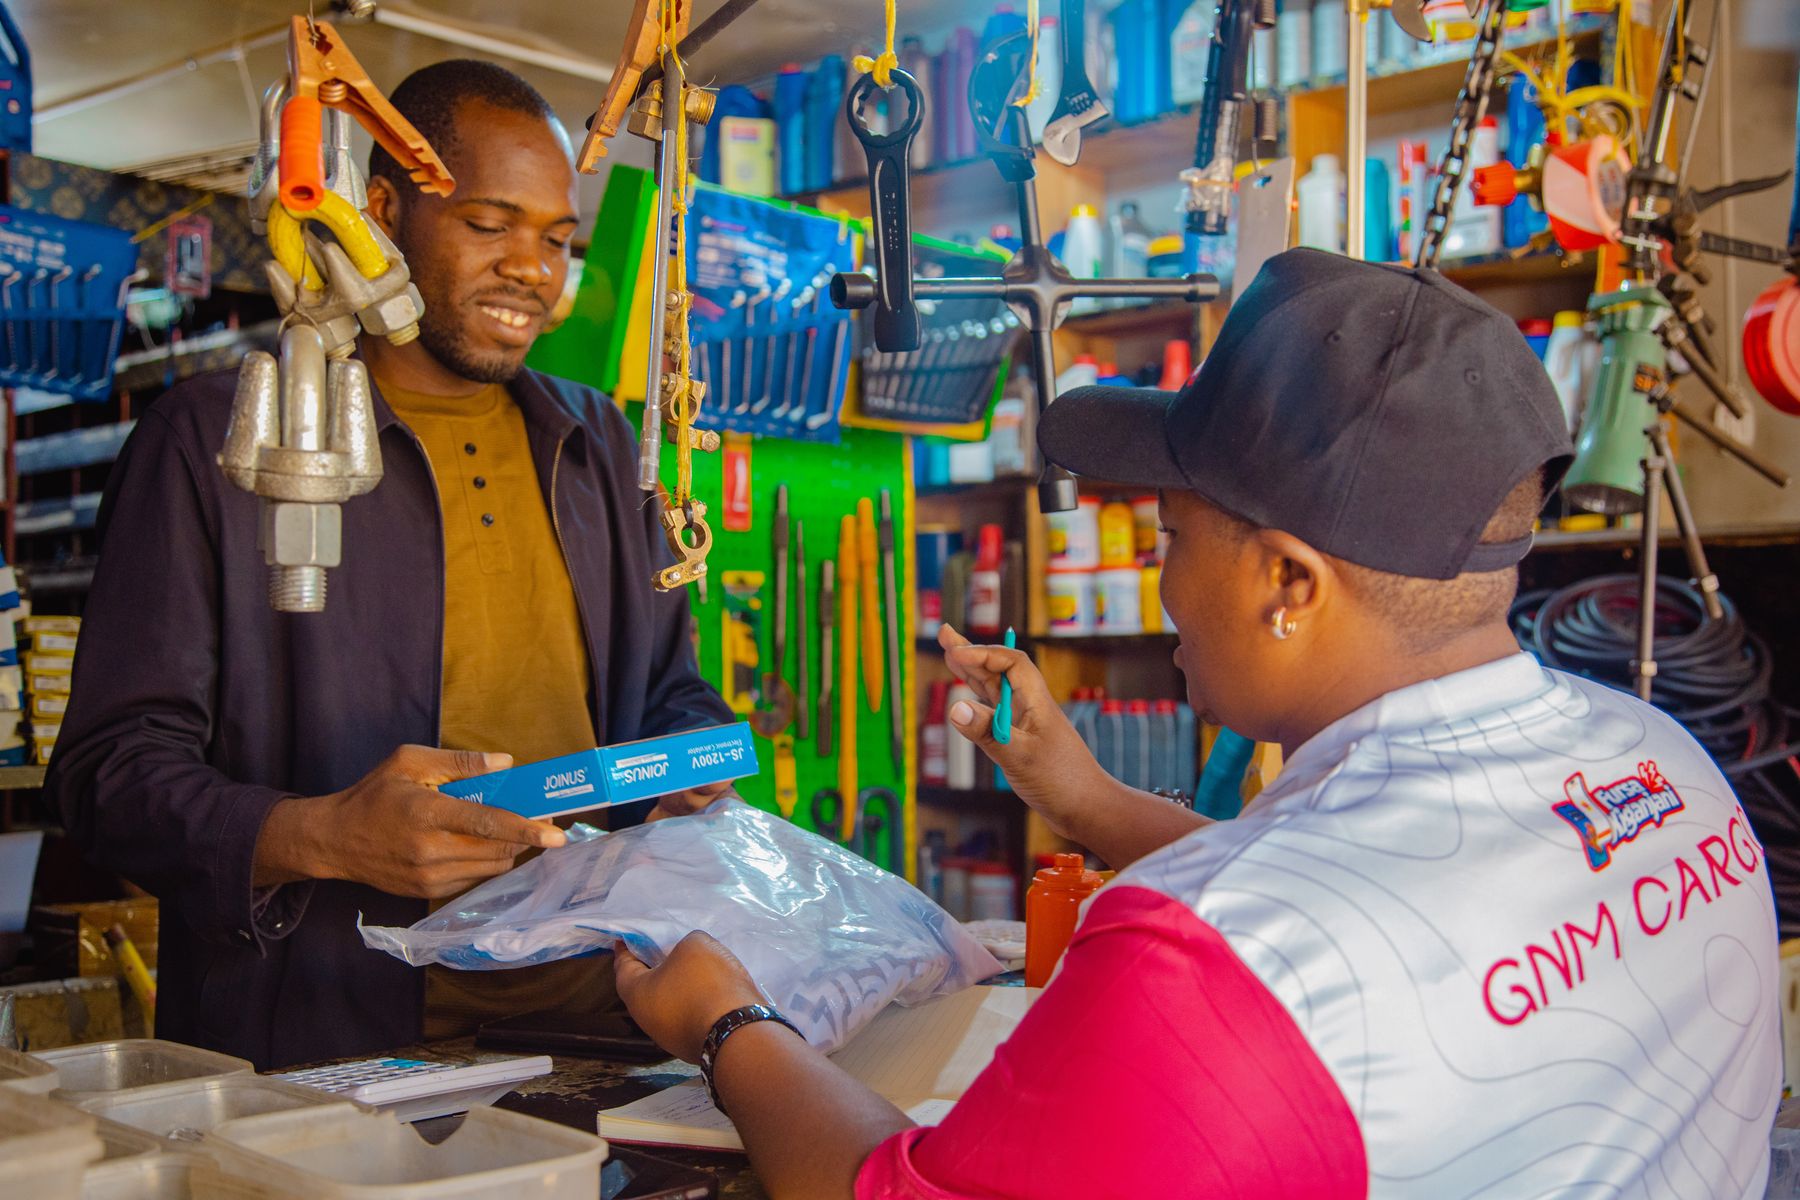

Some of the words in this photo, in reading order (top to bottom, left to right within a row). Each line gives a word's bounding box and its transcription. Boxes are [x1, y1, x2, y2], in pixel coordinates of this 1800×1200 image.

[716, 738, 743, 750] Electronic
[692, 748, 745, 769] JS-1200V
[543, 769, 586, 791] JOINUS
[624, 762, 669, 784] JOINUS
[1593, 779, 1647, 809] Fursa
[1608, 783, 1681, 844] Kiganjani
[1482, 901, 1621, 1026] GNM
